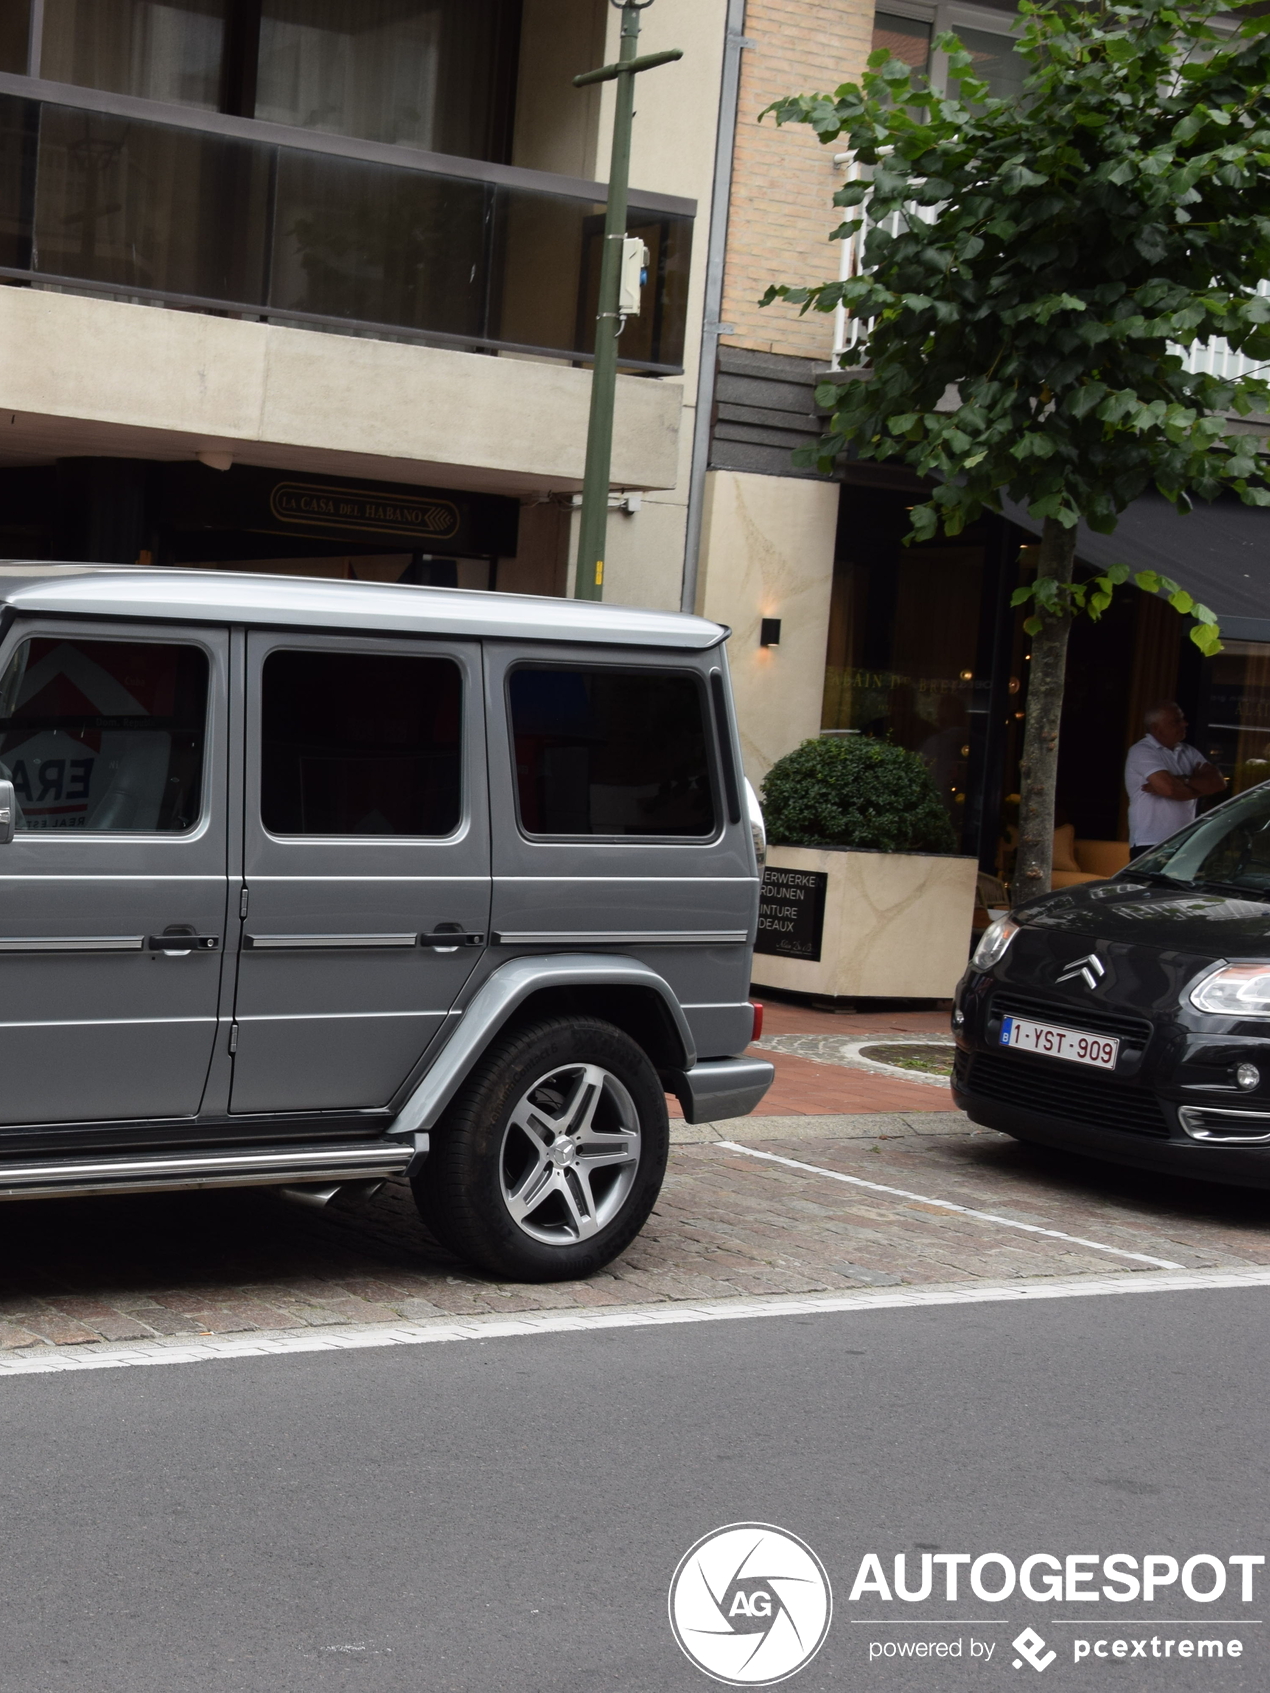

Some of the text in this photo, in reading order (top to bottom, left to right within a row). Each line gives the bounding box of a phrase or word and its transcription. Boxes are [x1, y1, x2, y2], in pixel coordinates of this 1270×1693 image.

[282, 496, 422, 524] LA CASA DEL HABANO
[758, 918, 794, 932] DEAUX
[1002, 1032, 1009, 1042] B
[1014, 1024, 1113, 1063] 1-YST-909
